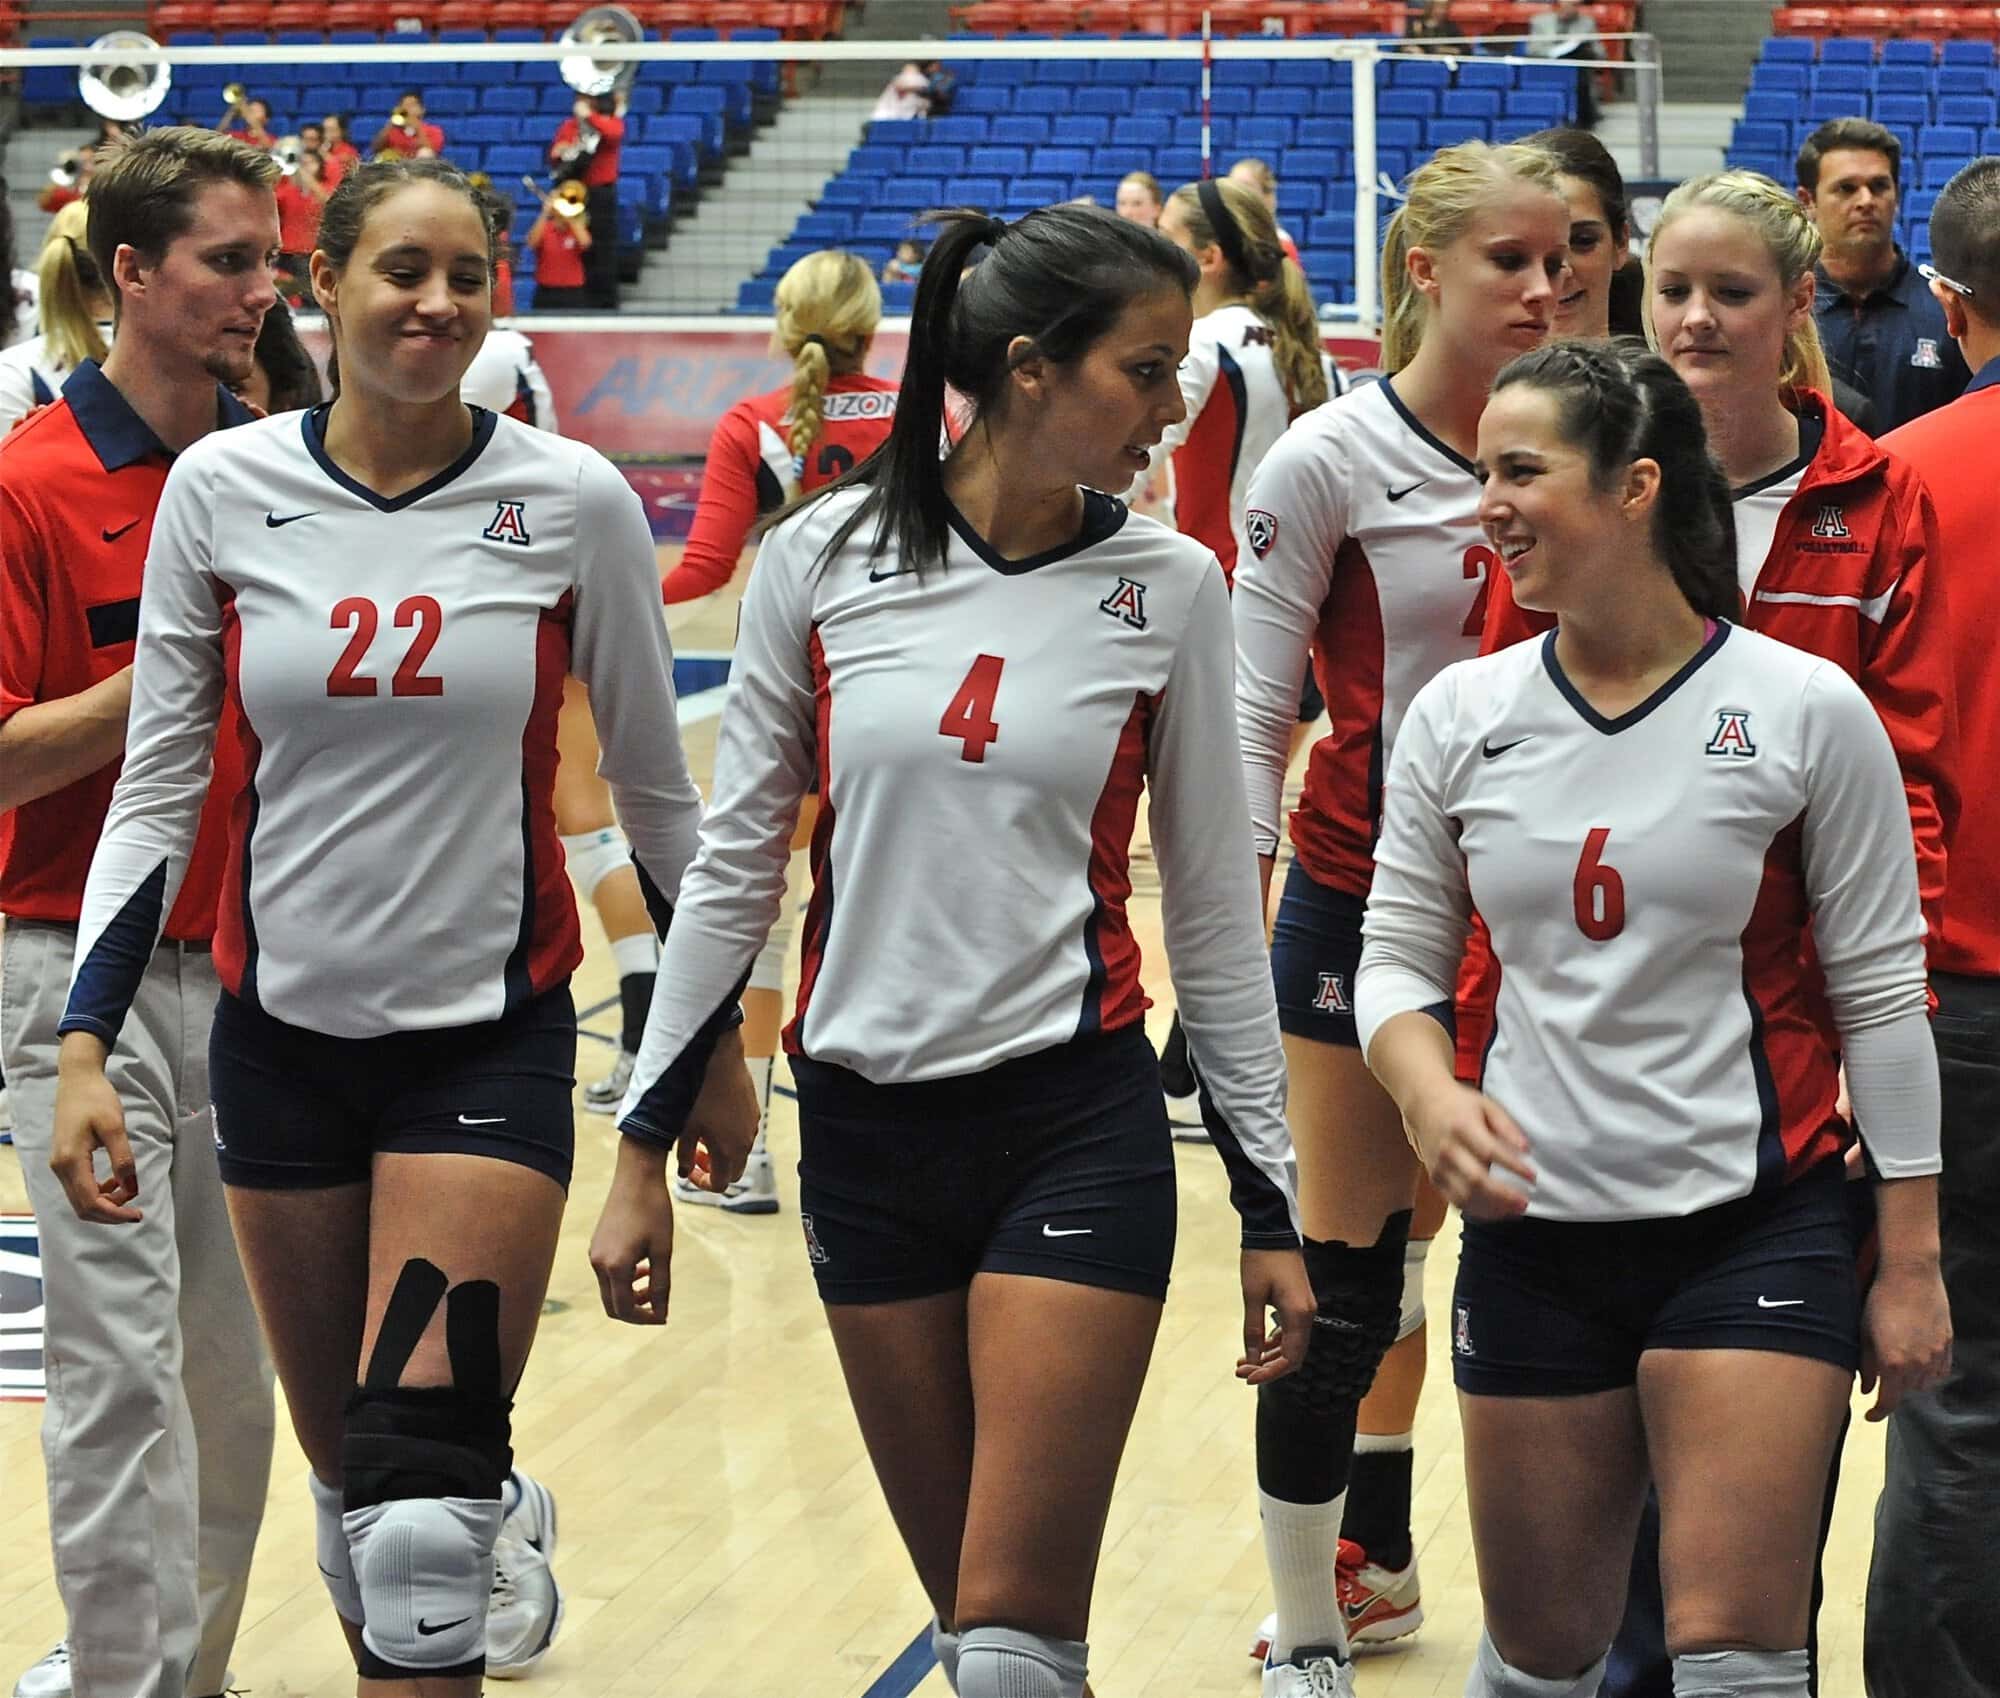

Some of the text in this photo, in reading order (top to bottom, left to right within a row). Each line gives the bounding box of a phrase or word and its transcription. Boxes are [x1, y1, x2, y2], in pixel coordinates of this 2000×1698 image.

[482, 500, 530, 546] A
[1811, 504, 1851, 538] A
[1099, 576, 1147, 631] A
[326, 595, 444, 697] 22
[938, 652, 1005, 764] 4
[1705, 712, 1756, 757] A
[1573, 827, 1625, 942] 6
[1312, 971, 1352, 1014] A
